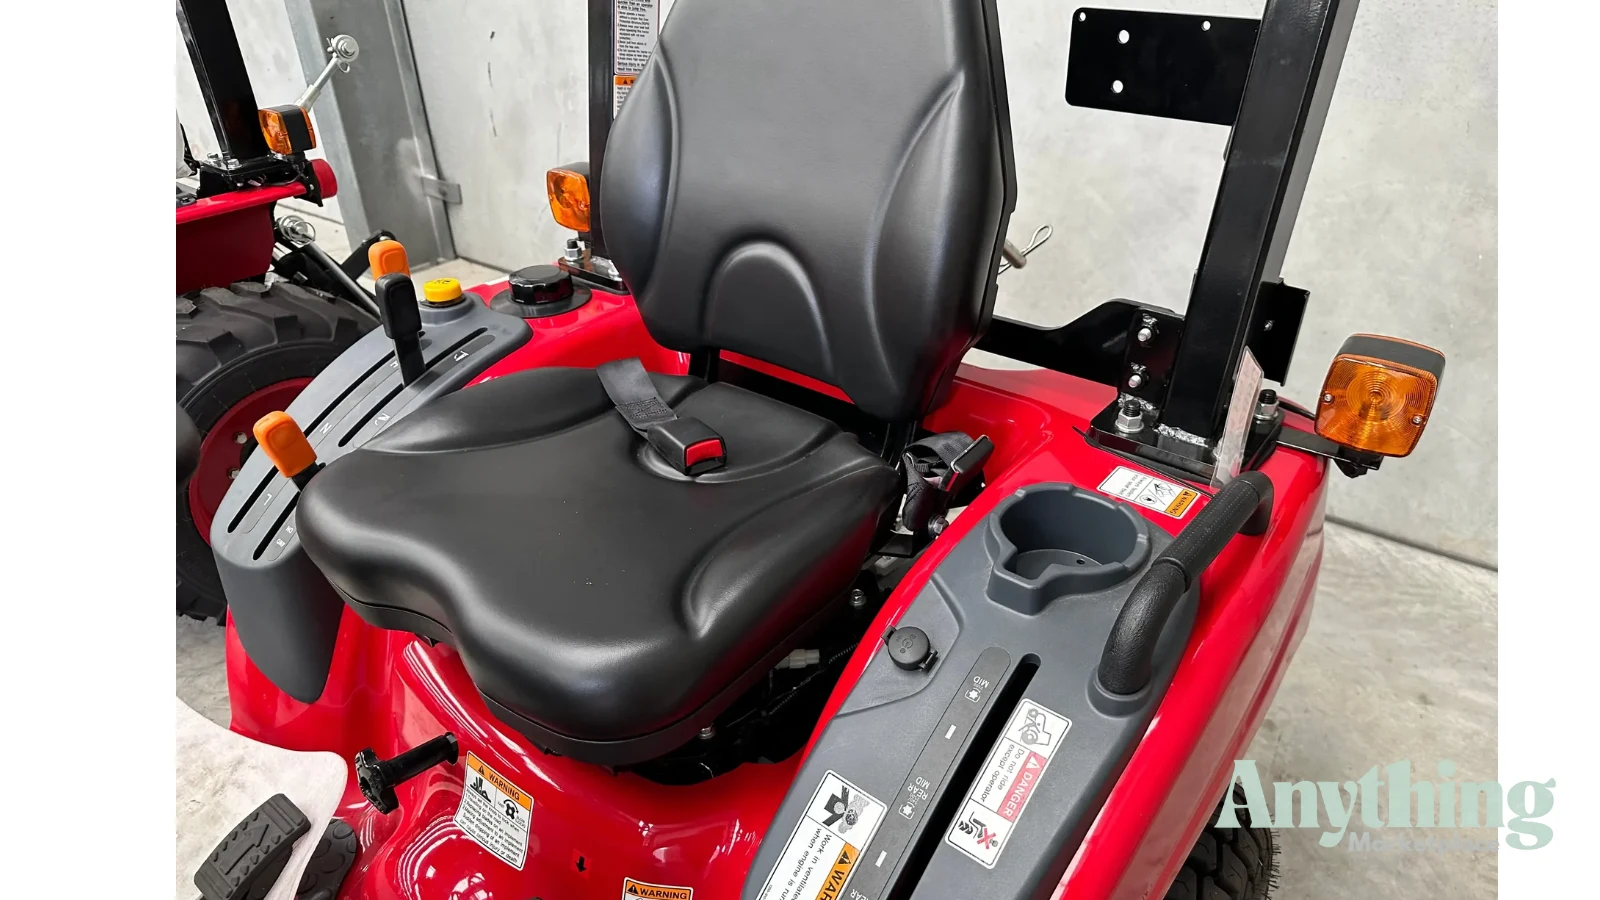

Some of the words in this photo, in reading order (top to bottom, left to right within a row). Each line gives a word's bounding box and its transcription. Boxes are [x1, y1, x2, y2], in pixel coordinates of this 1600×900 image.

[320, 422, 332, 434] N
[264, 493, 272, 505] L
[974, 676, 990, 688] MID
[998, 744, 1015, 769] except
[1015, 748, 1025, 759] Do
[1007, 761, 1016, 774] not
[489, 772, 520, 800] WARNING
[916, 777, 930, 789] MID
[980, 770, 1000, 802] operator
[998, 775, 1008, 790] ride
[908, 783, 928, 800] REAR
[1002, 771, 1032, 817] DANGER
[808, 828, 822, 849] when
[817, 834, 832, 854] Work
[792, 851, 809, 878] engine
[812, 856, 820, 864] in
[640, 888, 687, 900] WARNING
